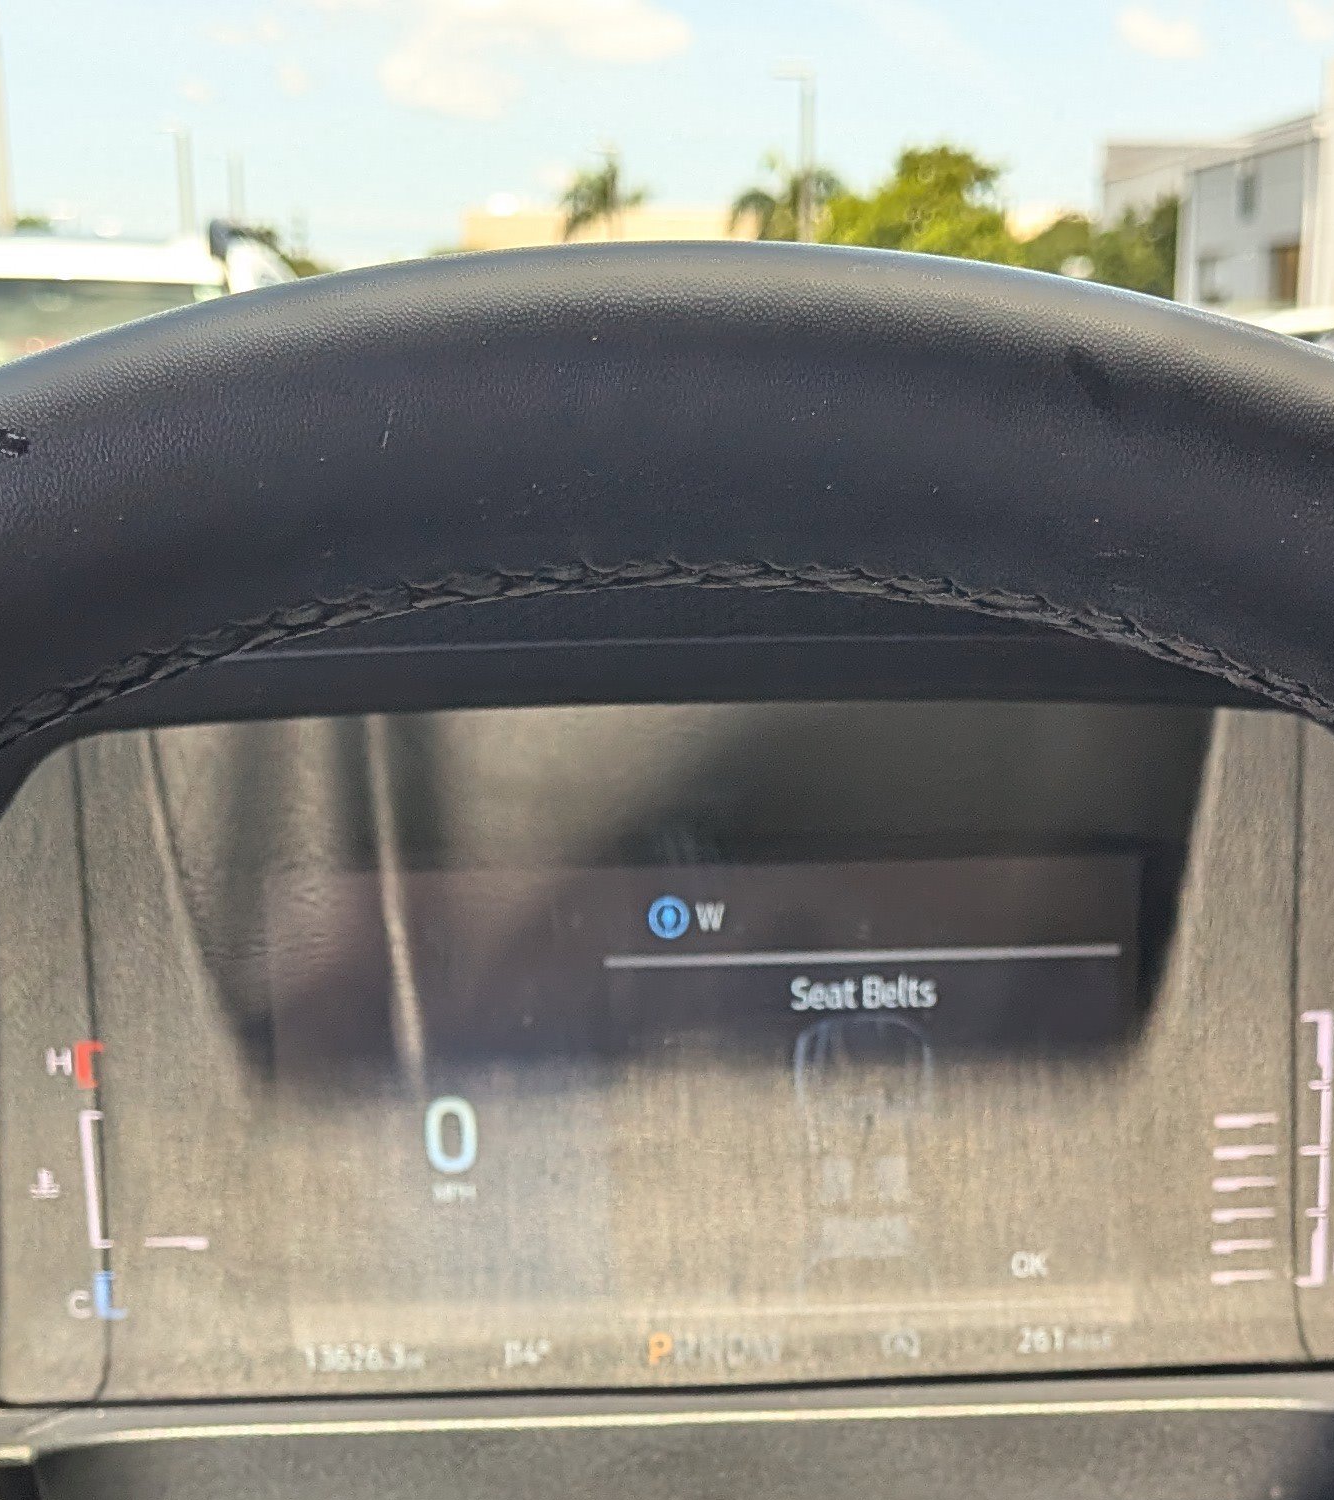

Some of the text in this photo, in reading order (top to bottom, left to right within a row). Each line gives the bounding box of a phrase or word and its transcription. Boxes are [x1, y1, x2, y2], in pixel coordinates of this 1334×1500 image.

[695, 901, 725, 932] W
[790, 973, 938, 1011] Seat Belts
[45, 1047, 72, 1076] H
[424, 1096, 478, 1174] 0
[1011, 1251, 1047, 1279] OK
[69, 1290, 92, 1319] C
[649, 1332, 673, 1366] P
